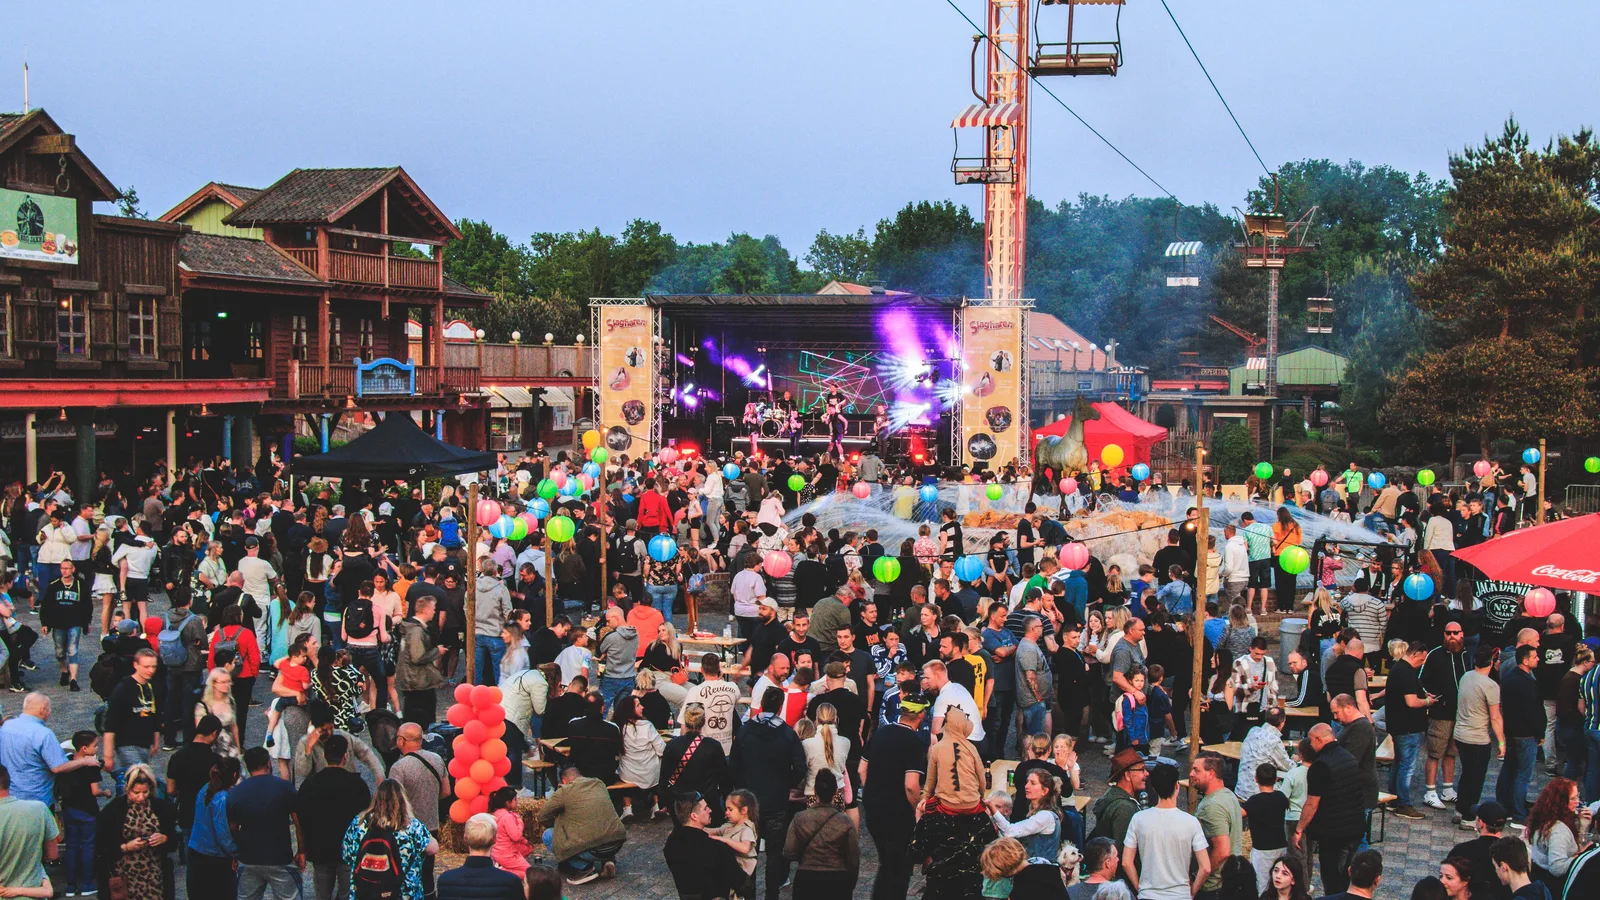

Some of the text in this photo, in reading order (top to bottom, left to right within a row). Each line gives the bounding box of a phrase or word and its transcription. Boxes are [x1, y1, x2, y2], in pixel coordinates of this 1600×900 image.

[606, 318, 646, 333] Slagharen
[970, 320, 1013, 335] Slagharen
[1531, 564, 1600, 584] Coca-Cola
[1475, 579, 1499, 598] JACK
[699, 684, 736, 699] Review
